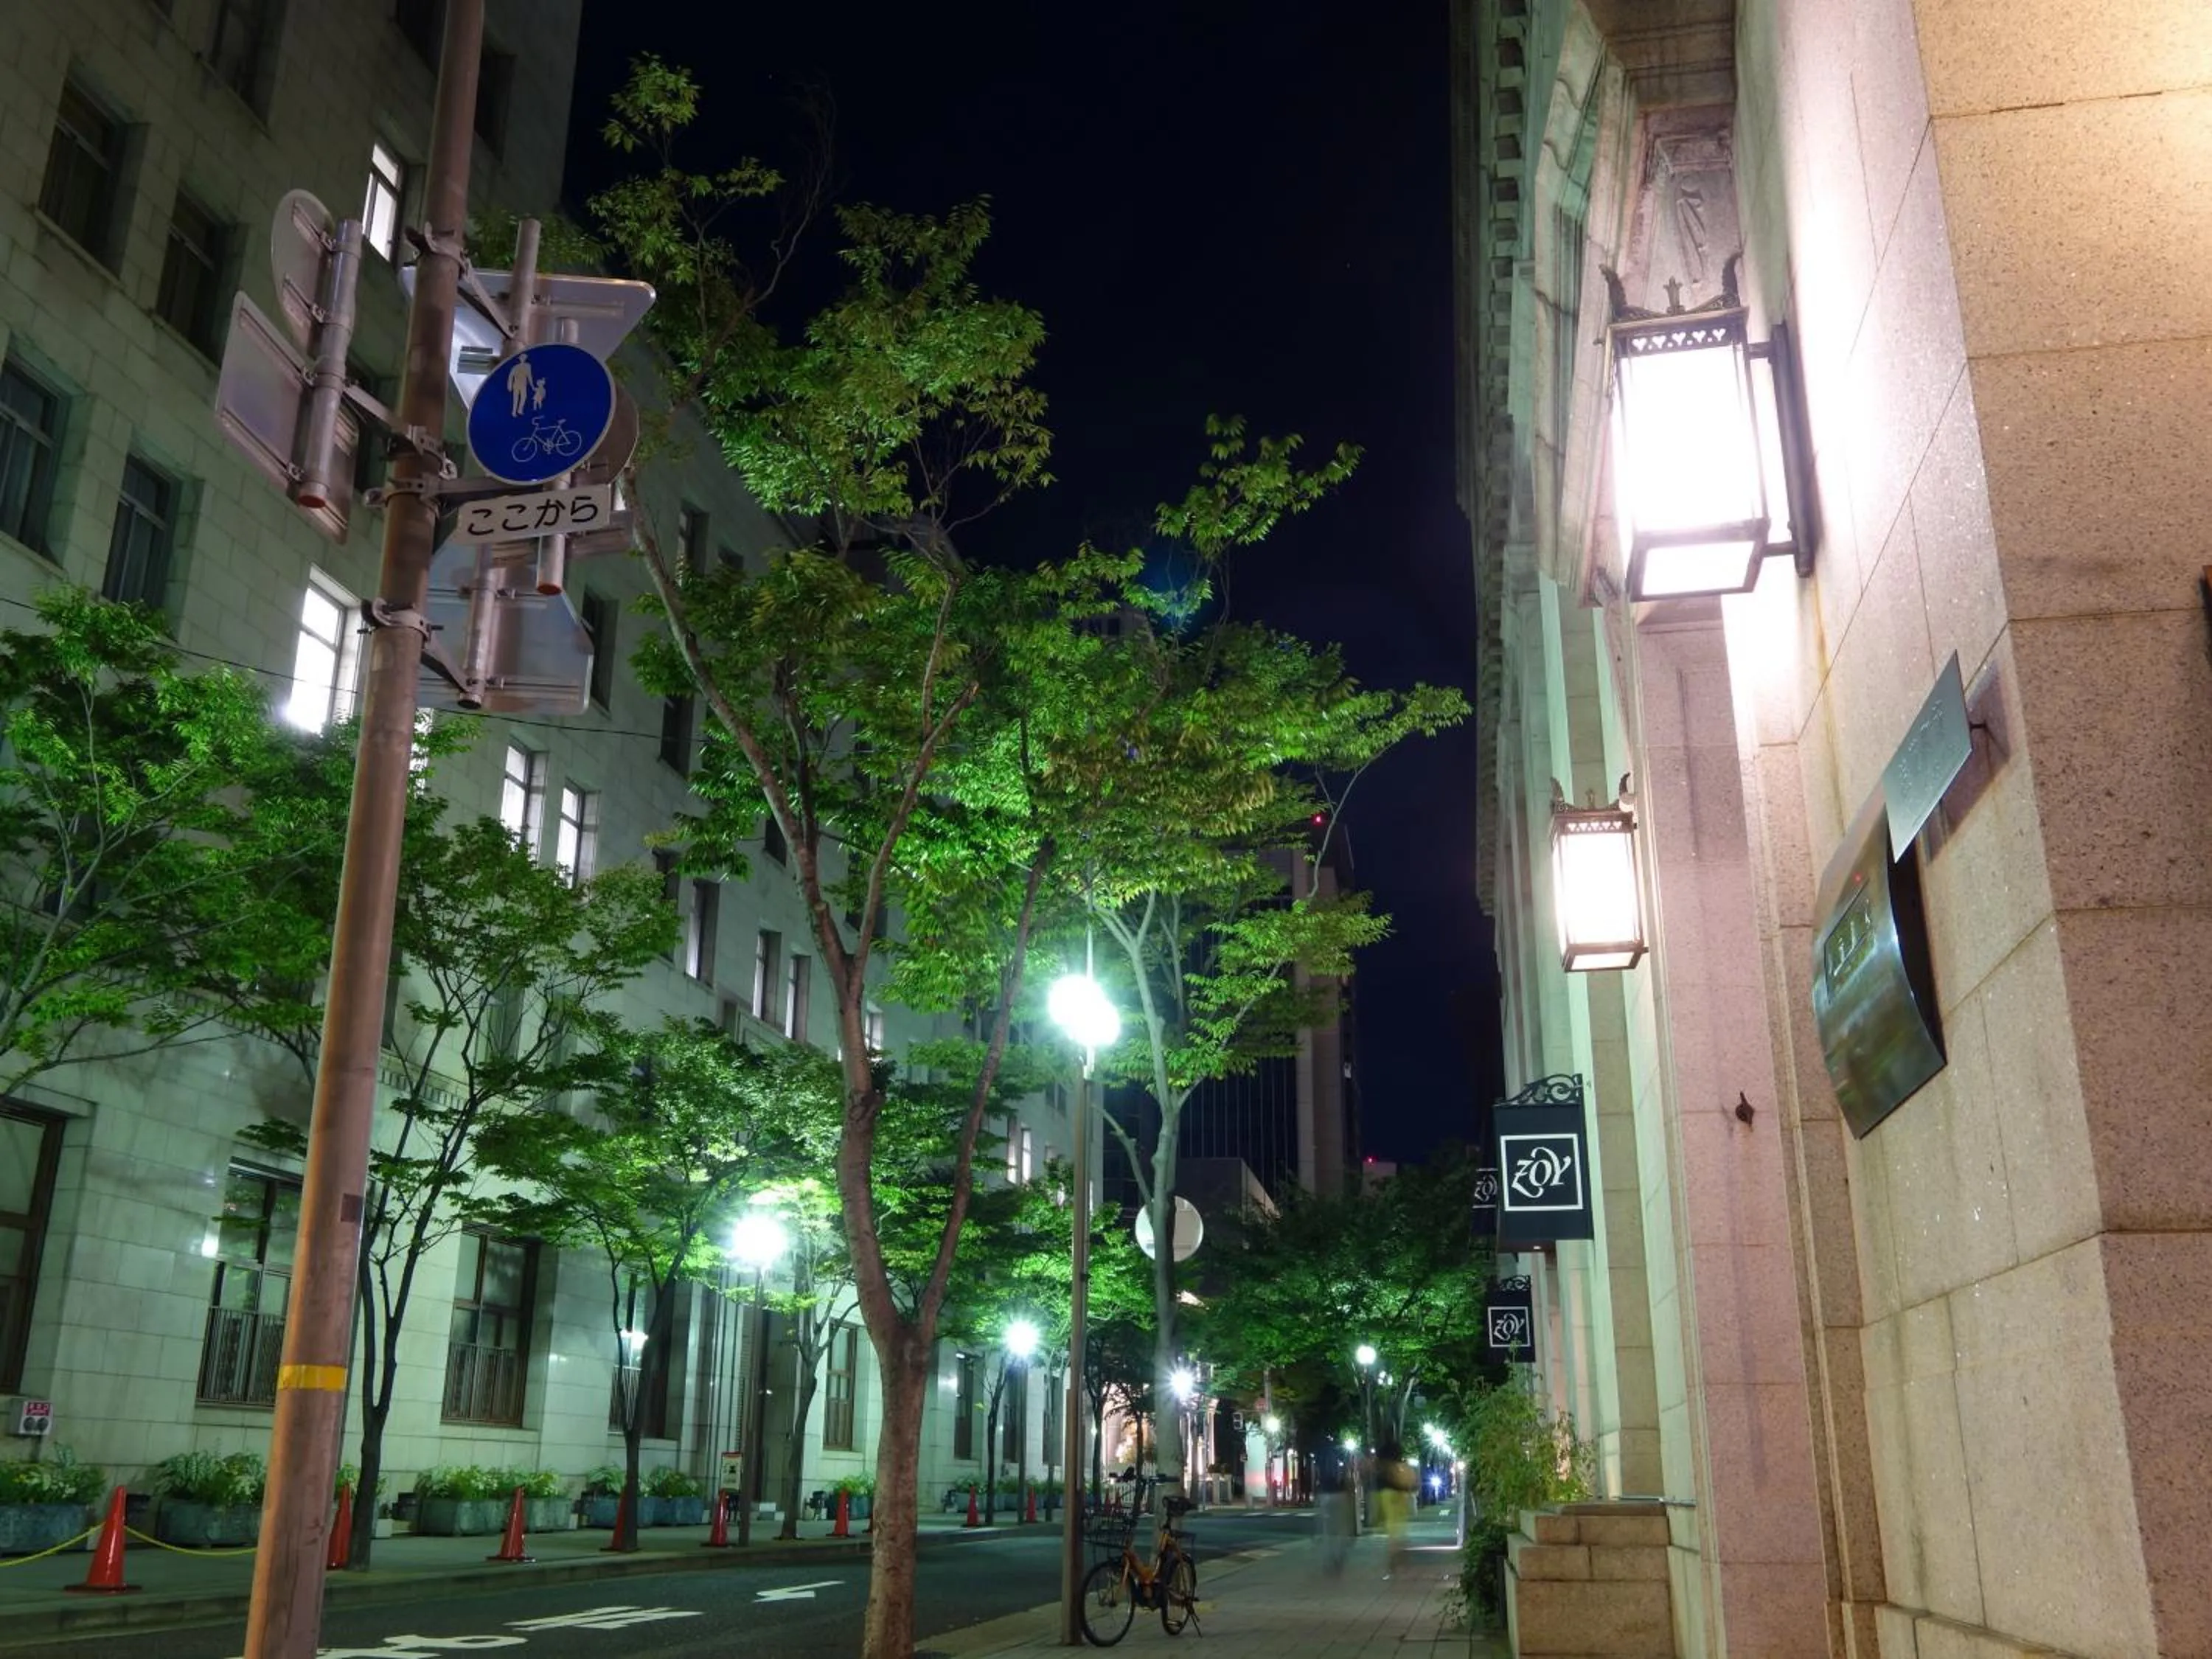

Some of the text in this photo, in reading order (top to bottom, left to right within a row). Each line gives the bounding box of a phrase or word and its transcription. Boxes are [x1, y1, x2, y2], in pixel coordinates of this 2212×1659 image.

[467, 495, 598, 535] ここから
[1512, 1147, 1571, 1198] ZOY
